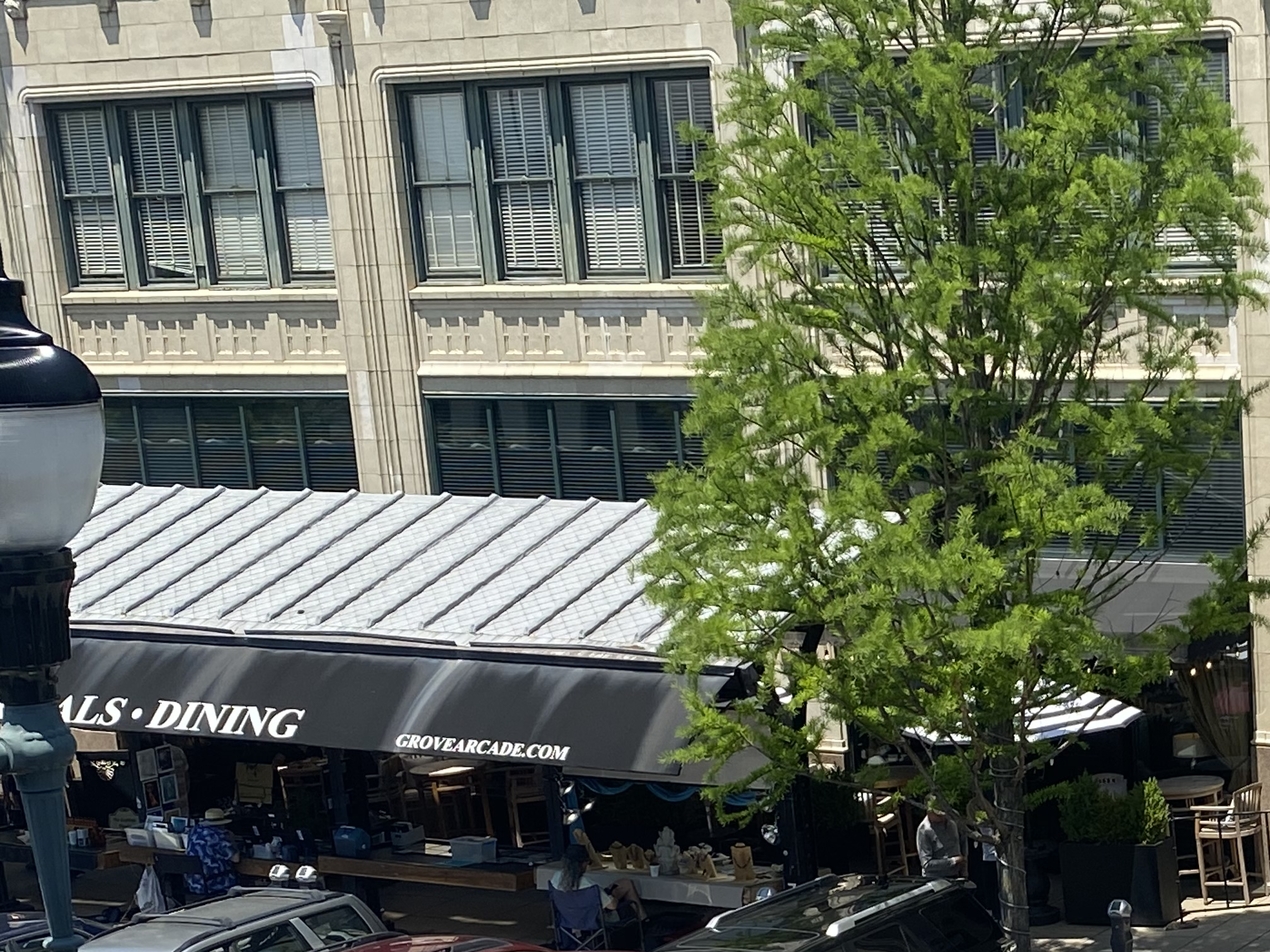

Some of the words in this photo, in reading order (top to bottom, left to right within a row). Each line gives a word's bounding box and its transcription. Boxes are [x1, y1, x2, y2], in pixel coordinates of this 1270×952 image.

[57, 694, 129, 727] ALS
[145, 699, 306, 739] DINING
[395, 733, 571, 761] GROVEARCADE.COM
